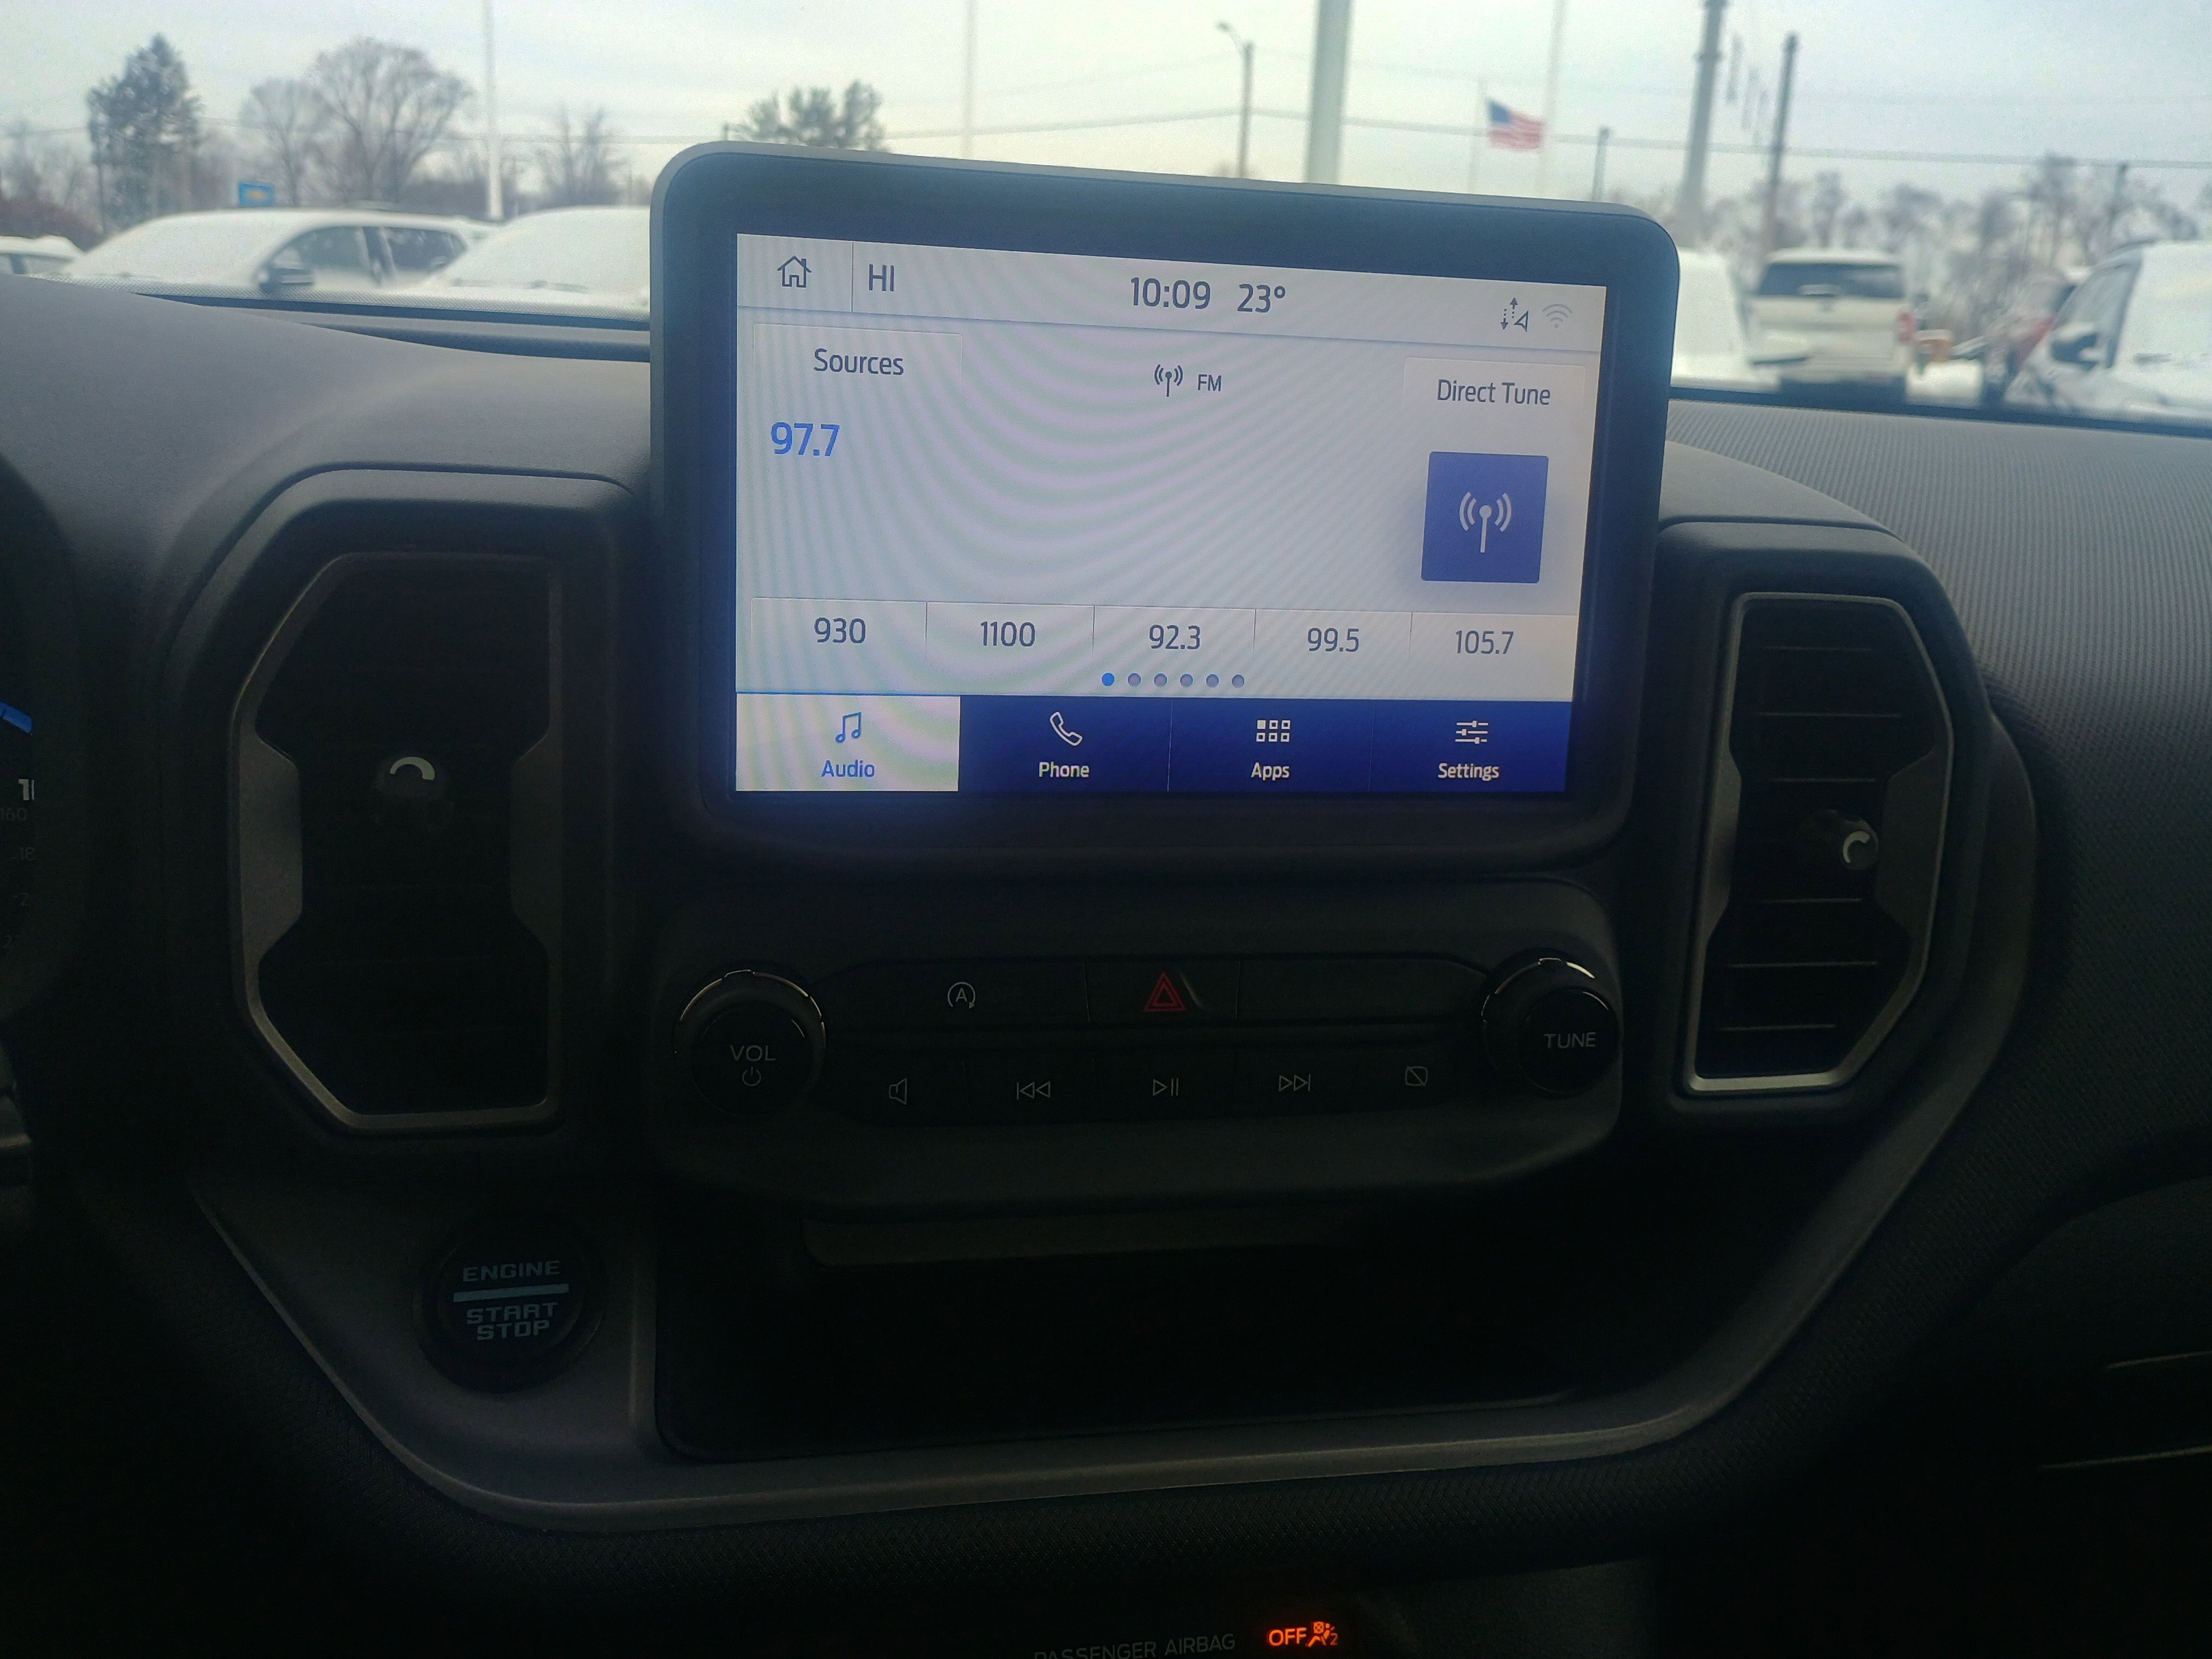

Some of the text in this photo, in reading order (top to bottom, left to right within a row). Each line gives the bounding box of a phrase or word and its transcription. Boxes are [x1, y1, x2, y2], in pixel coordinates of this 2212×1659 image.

[868, 264, 895, 292] HI
[1131, 276, 1286, 313] 10:09 23°
[813, 348, 904, 376] Sources
[1197, 374, 1223, 392] FM
[1437, 379, 1551, 406] Direct Tune
[771, 422, 840, 457] 97.7
[814, 617, 866, 644] 930
[981, 621, 1036, 647] 1100
[1149, 624, 1201, 650] 92.3
[1307, 628, 1360, 652] 99.5
[1455, 630, 1514, 655] 105.7
[821, 760, 875, 778] Audio
[1039, 761, 1090, 778] Phone
[1251, 762, 1290, 781] Apps
[1438, 763, 1500, 781] Settings
[1543, 1032, 1596, 1049] TUNE
[730, 1045, 777, 1062] VOL
[462, 1260, 560, 1282] ENGINE
[466, 1302, 558, 1325] START
[477, 1319, 550, 1340] STOP
[1165, 1634, 1236, 1656] AIRBAG
[1269, 1627, 1307, 1647] OFF
